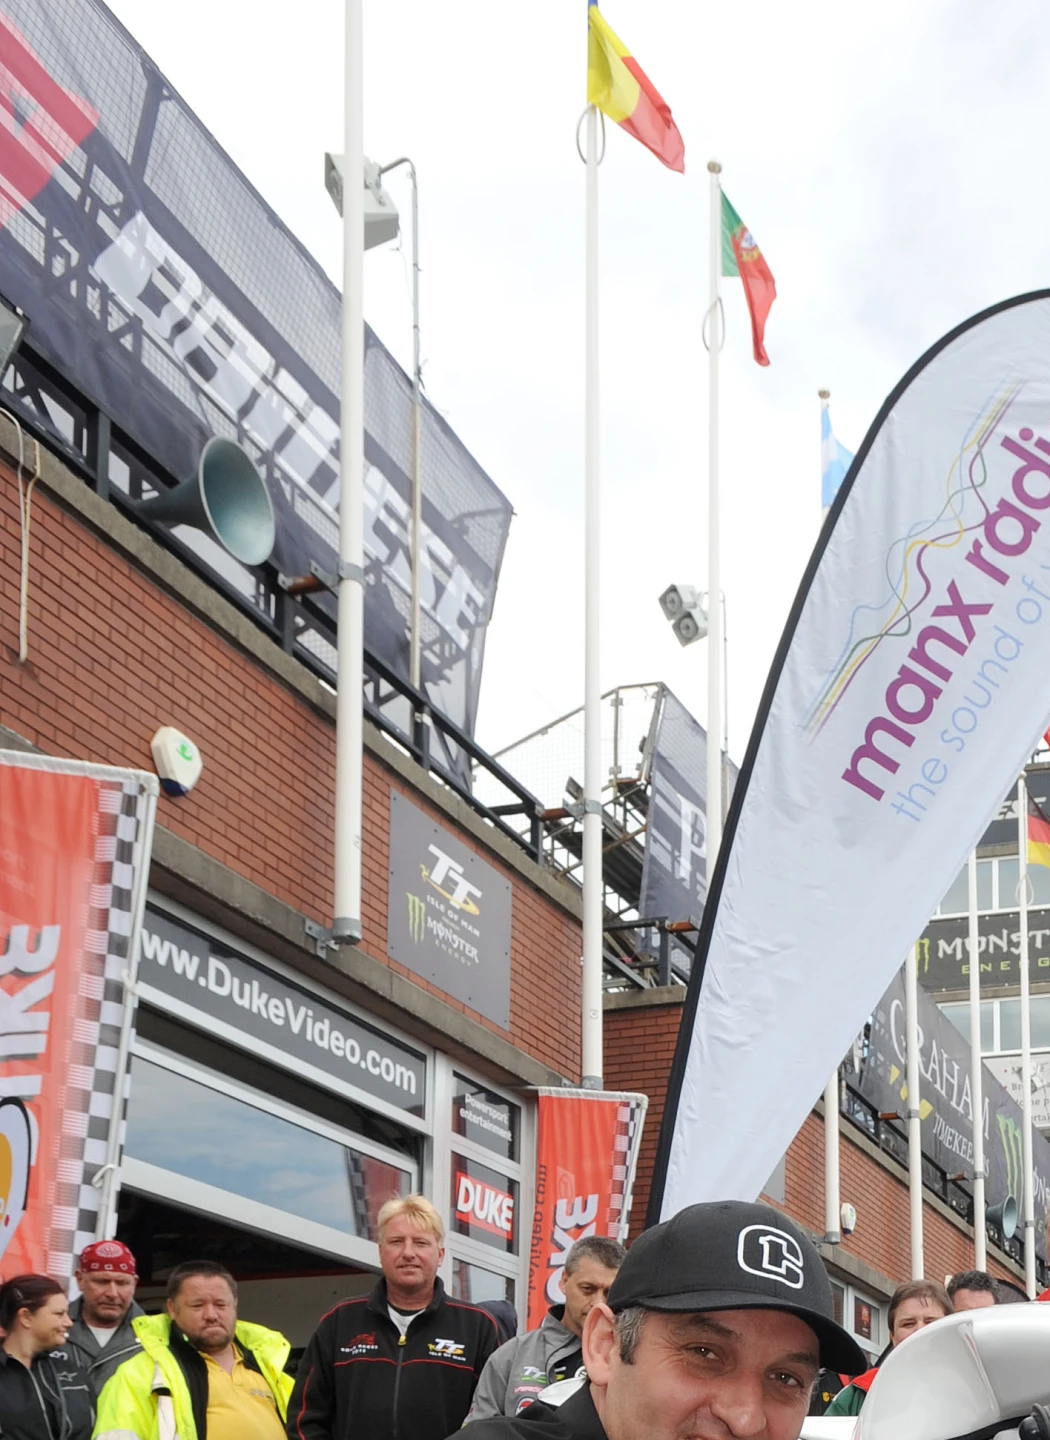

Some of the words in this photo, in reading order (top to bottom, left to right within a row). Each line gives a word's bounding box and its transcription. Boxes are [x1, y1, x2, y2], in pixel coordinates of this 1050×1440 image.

[841, 577, 994, 802] manx
[890, 757, 948, 823] the
[940, 625, 1024, 752] sound
[1015, 574, 1050, 625] of
[428, 843, 482, 910] TT
[426, 894, 445, 913] ISLE
[447, 910, 459, 922] OF
[460, 918, 480, 938] MAN
[426, 916, 480, 964] MONSTER
[139, 927, 418, 1096] ww.DukeVideo.com
[459, 1106, 513, 1142] entertainment
[464, 1092, 509, 1125] Powersport
[456, 1175, 514, 1234] DUKE
[435, 1338, 465, 1354] TT
